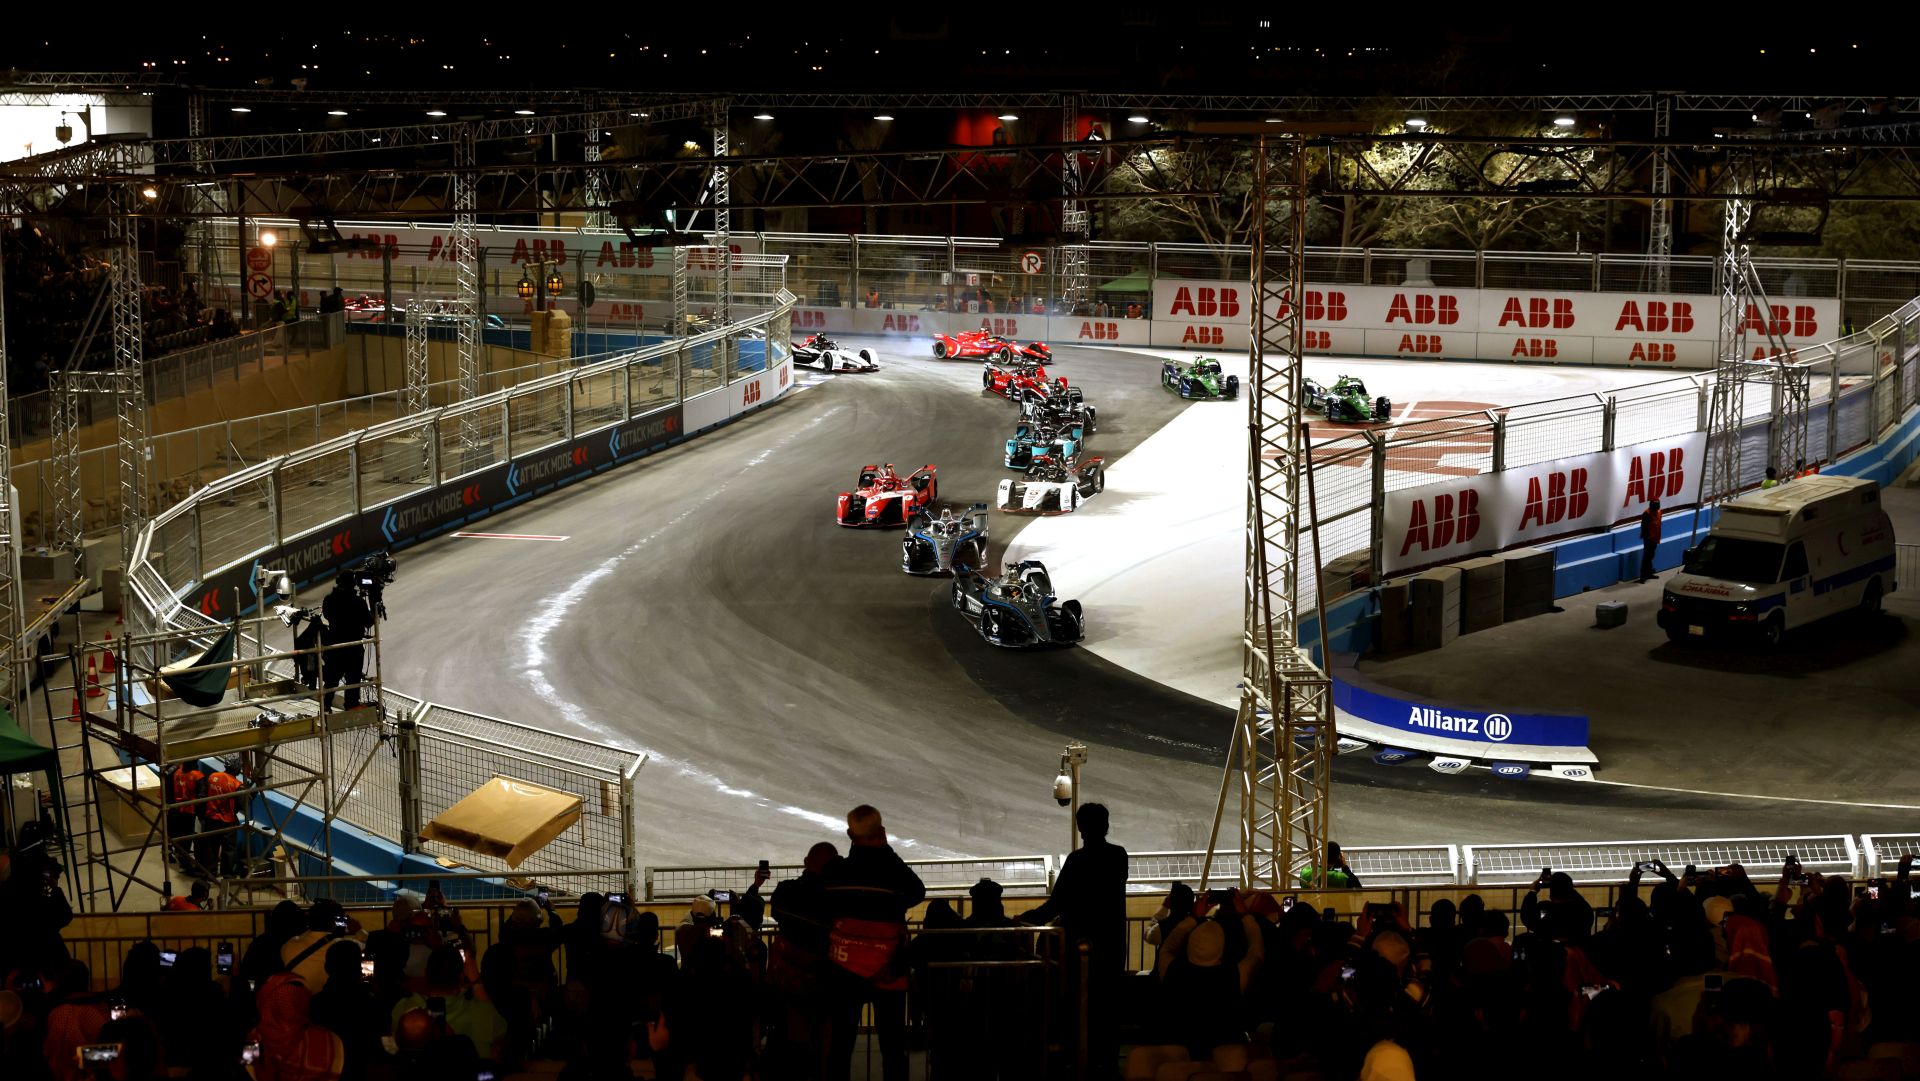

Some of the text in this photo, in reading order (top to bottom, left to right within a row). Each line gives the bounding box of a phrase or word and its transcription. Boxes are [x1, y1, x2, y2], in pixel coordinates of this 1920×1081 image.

[511, 239, 566, 266] ABB
[597, 241, 653, 268] ABB
[609, 304, 644, 320] ABB
[1170, 287, 1240, 318] ABB
[1385, 294, 1459, 325] ABB
[1498, 297, 1575, 329] ABB
[791, 311, 826, 328] ABB
[883, 314, 919, 332] ABB
[980, 318, 1018, 336] ABB
[1616, 300, 1694, 333] ABB
[1736, 304, 1818, 337] ABB
[1079, 322, 1119, 340] ABB
[1183, 325, 1224, 345] ABB
[1299, 330, 1331, 349] BB
[1398, 334, 1442, 354] ABB
[1512, 338, 1558, 358] ABB
[1629, 342, 1676, 363] ABB
[743, 380, 761, 406] ABB
[520, 451, 573, 485] ATTACK MODE
[1625, 448, 1684, 507] ABB
[398, 490, 463, 530] ATTACK MODE
[1519, 468, 1589, 531] ABB
[1400, 488, 1481, 557] ABB
[303, 539, 332, 569] MODE
[1409, 706, 1479, 733] Allianz
